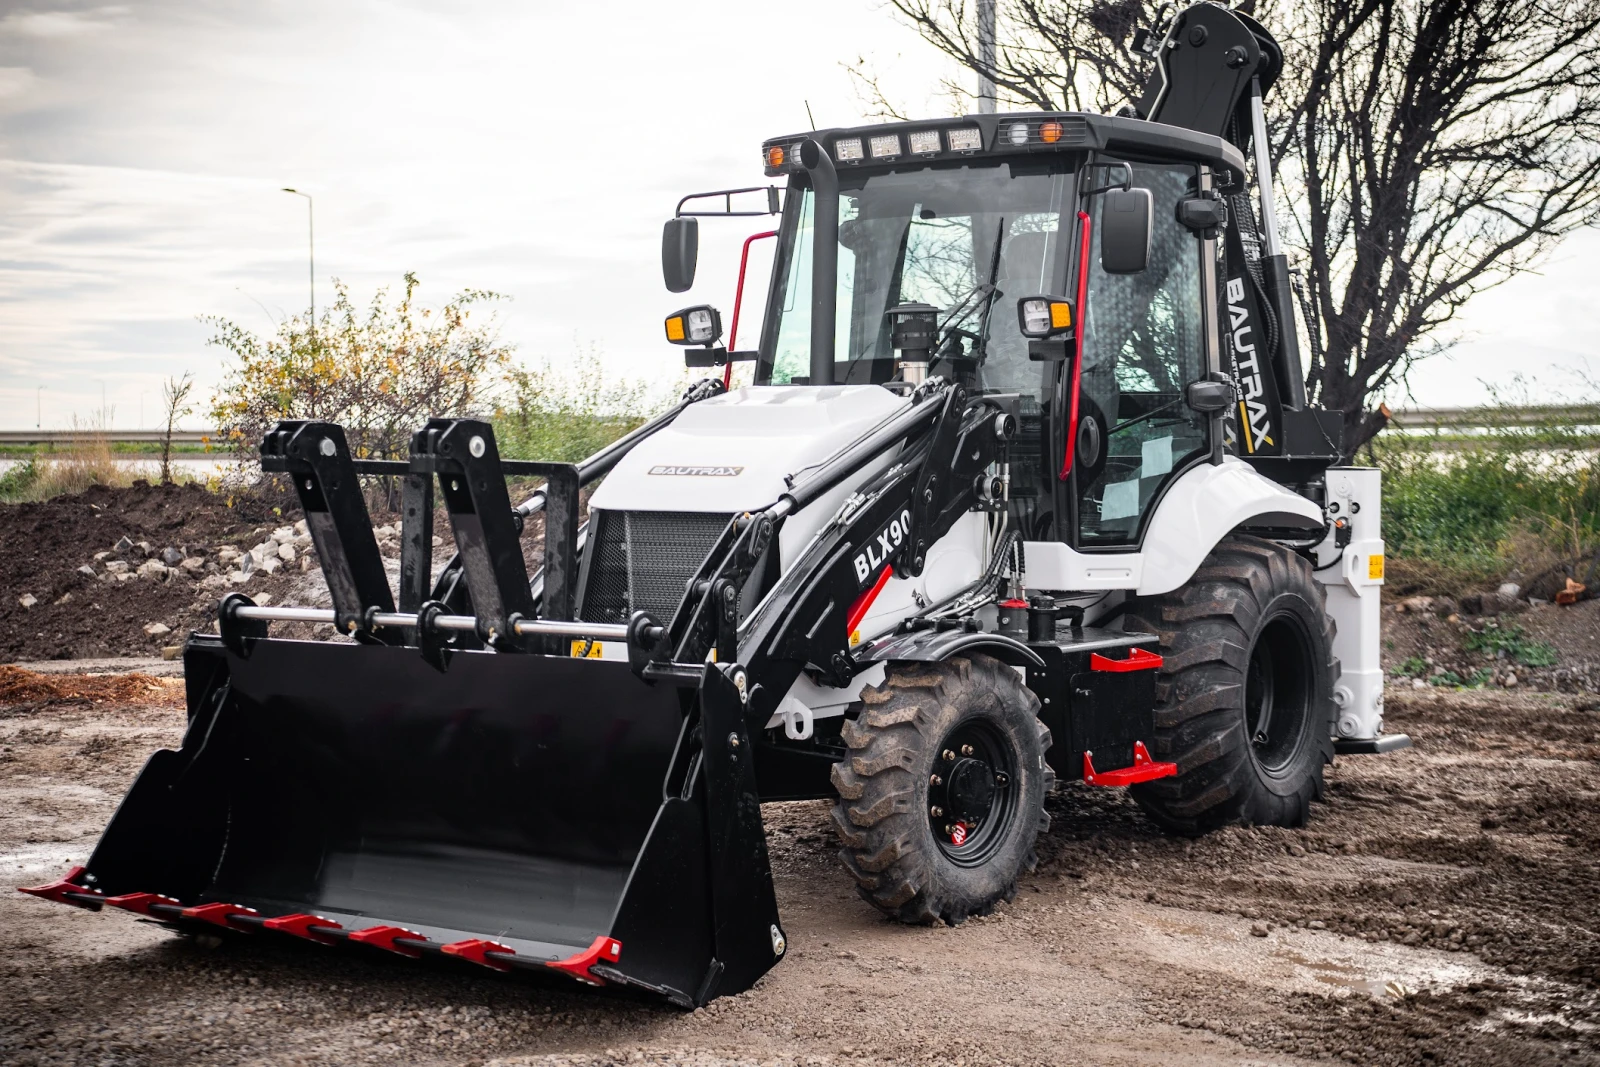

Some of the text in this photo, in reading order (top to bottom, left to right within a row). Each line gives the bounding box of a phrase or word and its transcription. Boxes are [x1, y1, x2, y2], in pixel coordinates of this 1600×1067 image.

[1226, 277, 1274, 450] BAUTRAX
[650, 466, 741, 476] BAUTRAX
[854, 509, 911, 583] BLX90
